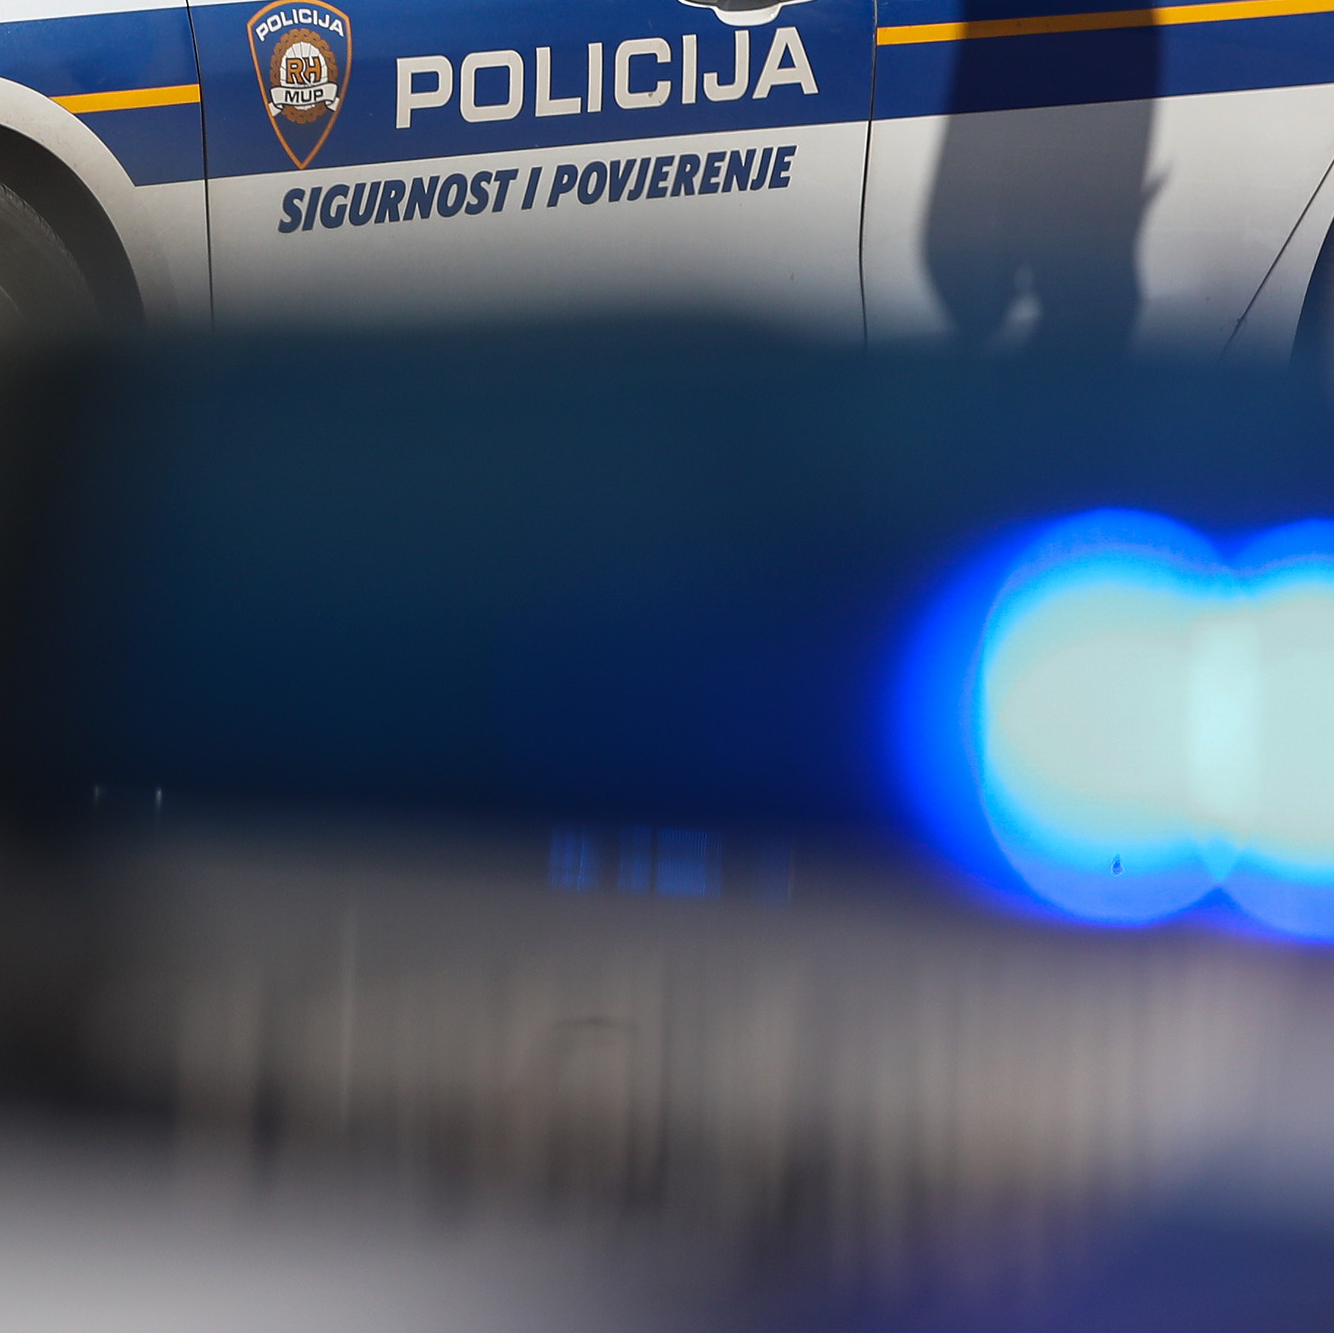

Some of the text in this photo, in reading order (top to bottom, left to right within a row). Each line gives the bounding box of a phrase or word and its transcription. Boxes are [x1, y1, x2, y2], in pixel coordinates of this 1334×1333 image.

[255, 8, 345, 42] POLICIJA
[285, 57, 322, 85] RH
[394, 26, 820, 129] POLICIJA
[284, 89, 324, 103] MUP
[277, 144, 798, 234] SIGURNOST I POVJERENJE
